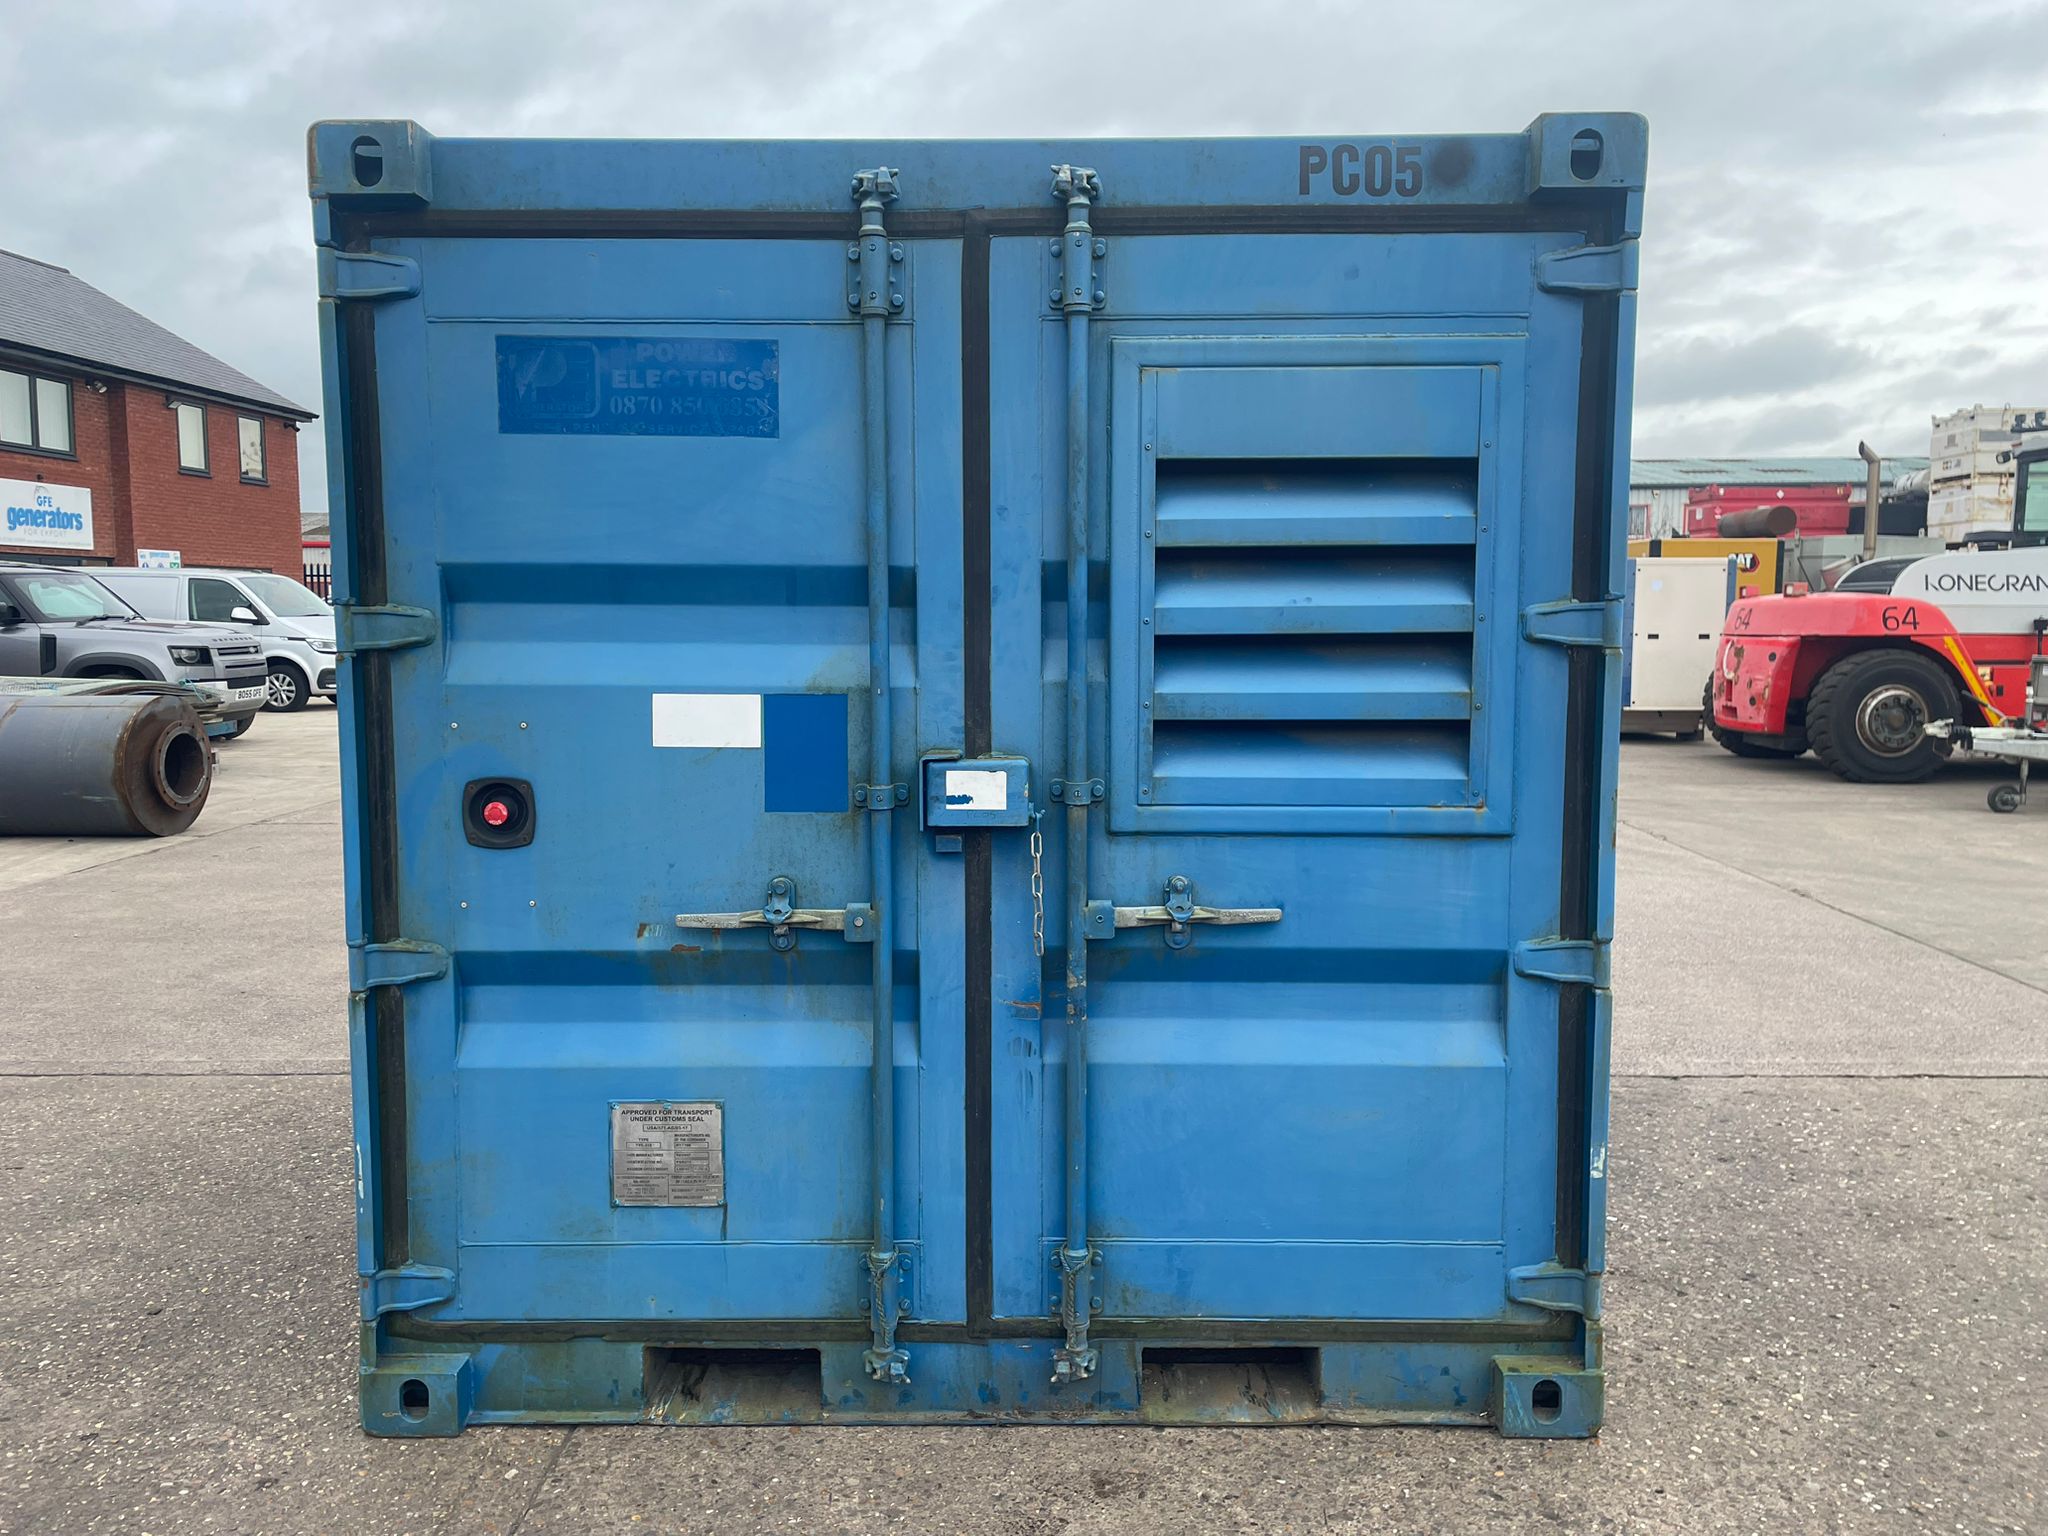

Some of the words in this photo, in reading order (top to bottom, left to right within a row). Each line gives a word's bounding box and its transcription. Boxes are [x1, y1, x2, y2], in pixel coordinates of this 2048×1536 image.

[1298, 144, 1424, 197] PC05
[611, 369, 765, 391] ELECTRICS
[609, 396, 663, 415] 0870
[36, 495, 53, 508] GFE
[7, 507, 83, 531] generators
[1735, 607, 1753, 631] 64
[1882, 606, 1920, 631] 64
